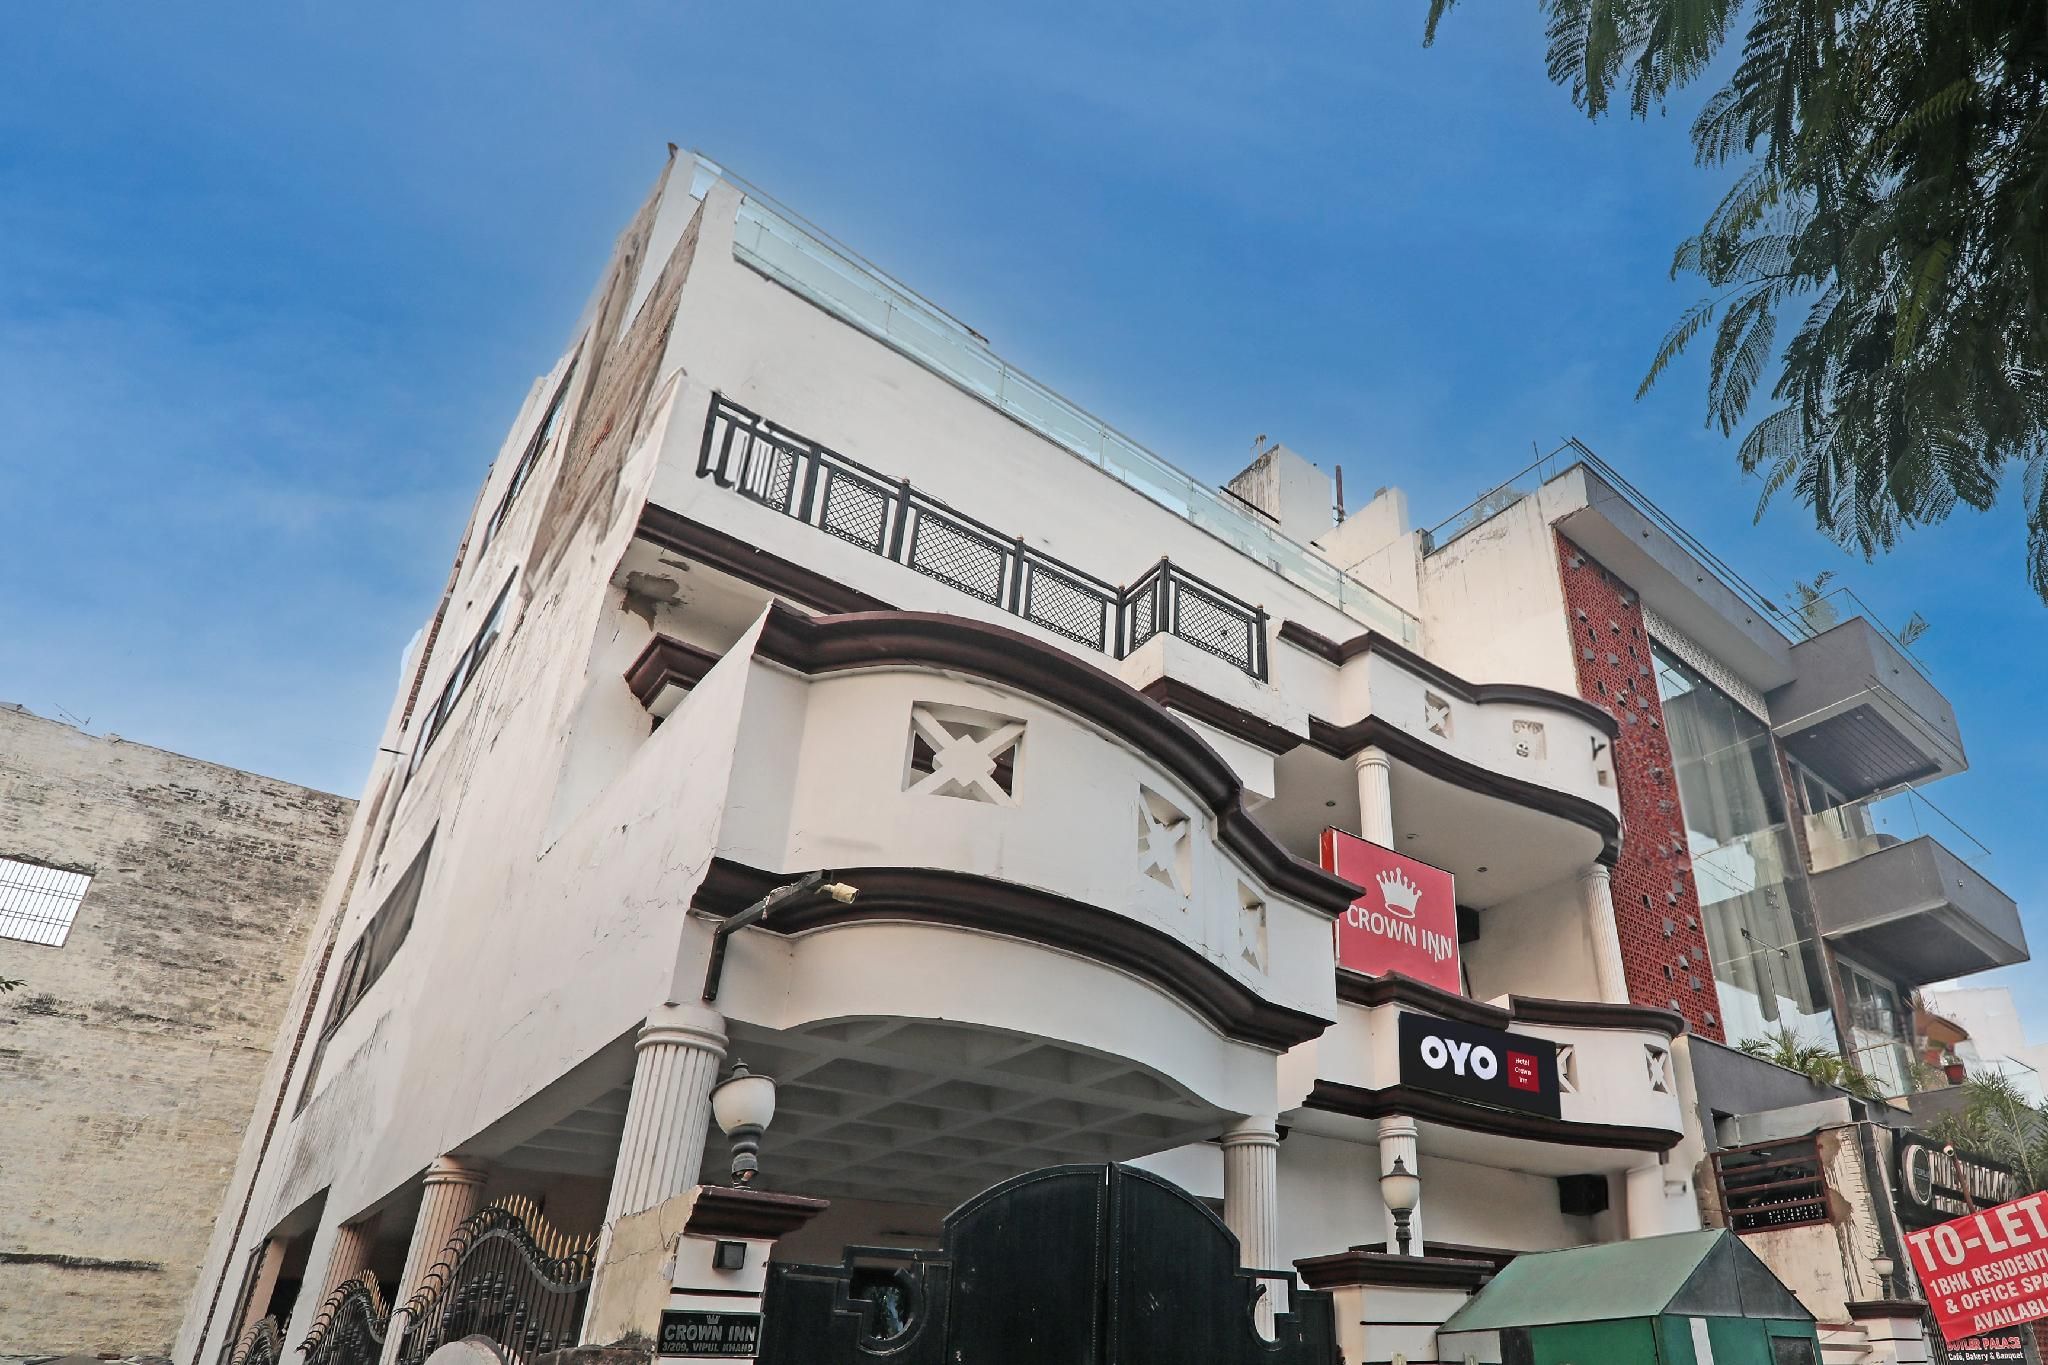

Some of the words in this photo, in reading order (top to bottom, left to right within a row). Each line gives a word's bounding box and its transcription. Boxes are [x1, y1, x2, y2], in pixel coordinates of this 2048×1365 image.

[1347, 904, 1417, 947] CROWN
[1421, 929, 1452, 963] INN
[1420, 1035, 1498, 1080] OYO
[1908, 1196, 2048, 1272] TO-LET
[1930, 1271, 1972, 1298] 1BHK
[1945, 1298, 1960, 1314] &
[1960, 1281, 2020, 1310] OFFICE
[1973, 1295, 2048, 1332] AVAILABL
[662, 1342, 689, 1353] 3/209,
[692, 1343, 719, 1352] VIPUL
[721, 1343, 754, 1353] KHAND
[664, 1324, 723, 1341] CROWN
[728, 1325, 756, 1342] INN
[1965, 1353, 1988, 1361] Bakery
[1996, 1351, 2024, 1361] Banquet
